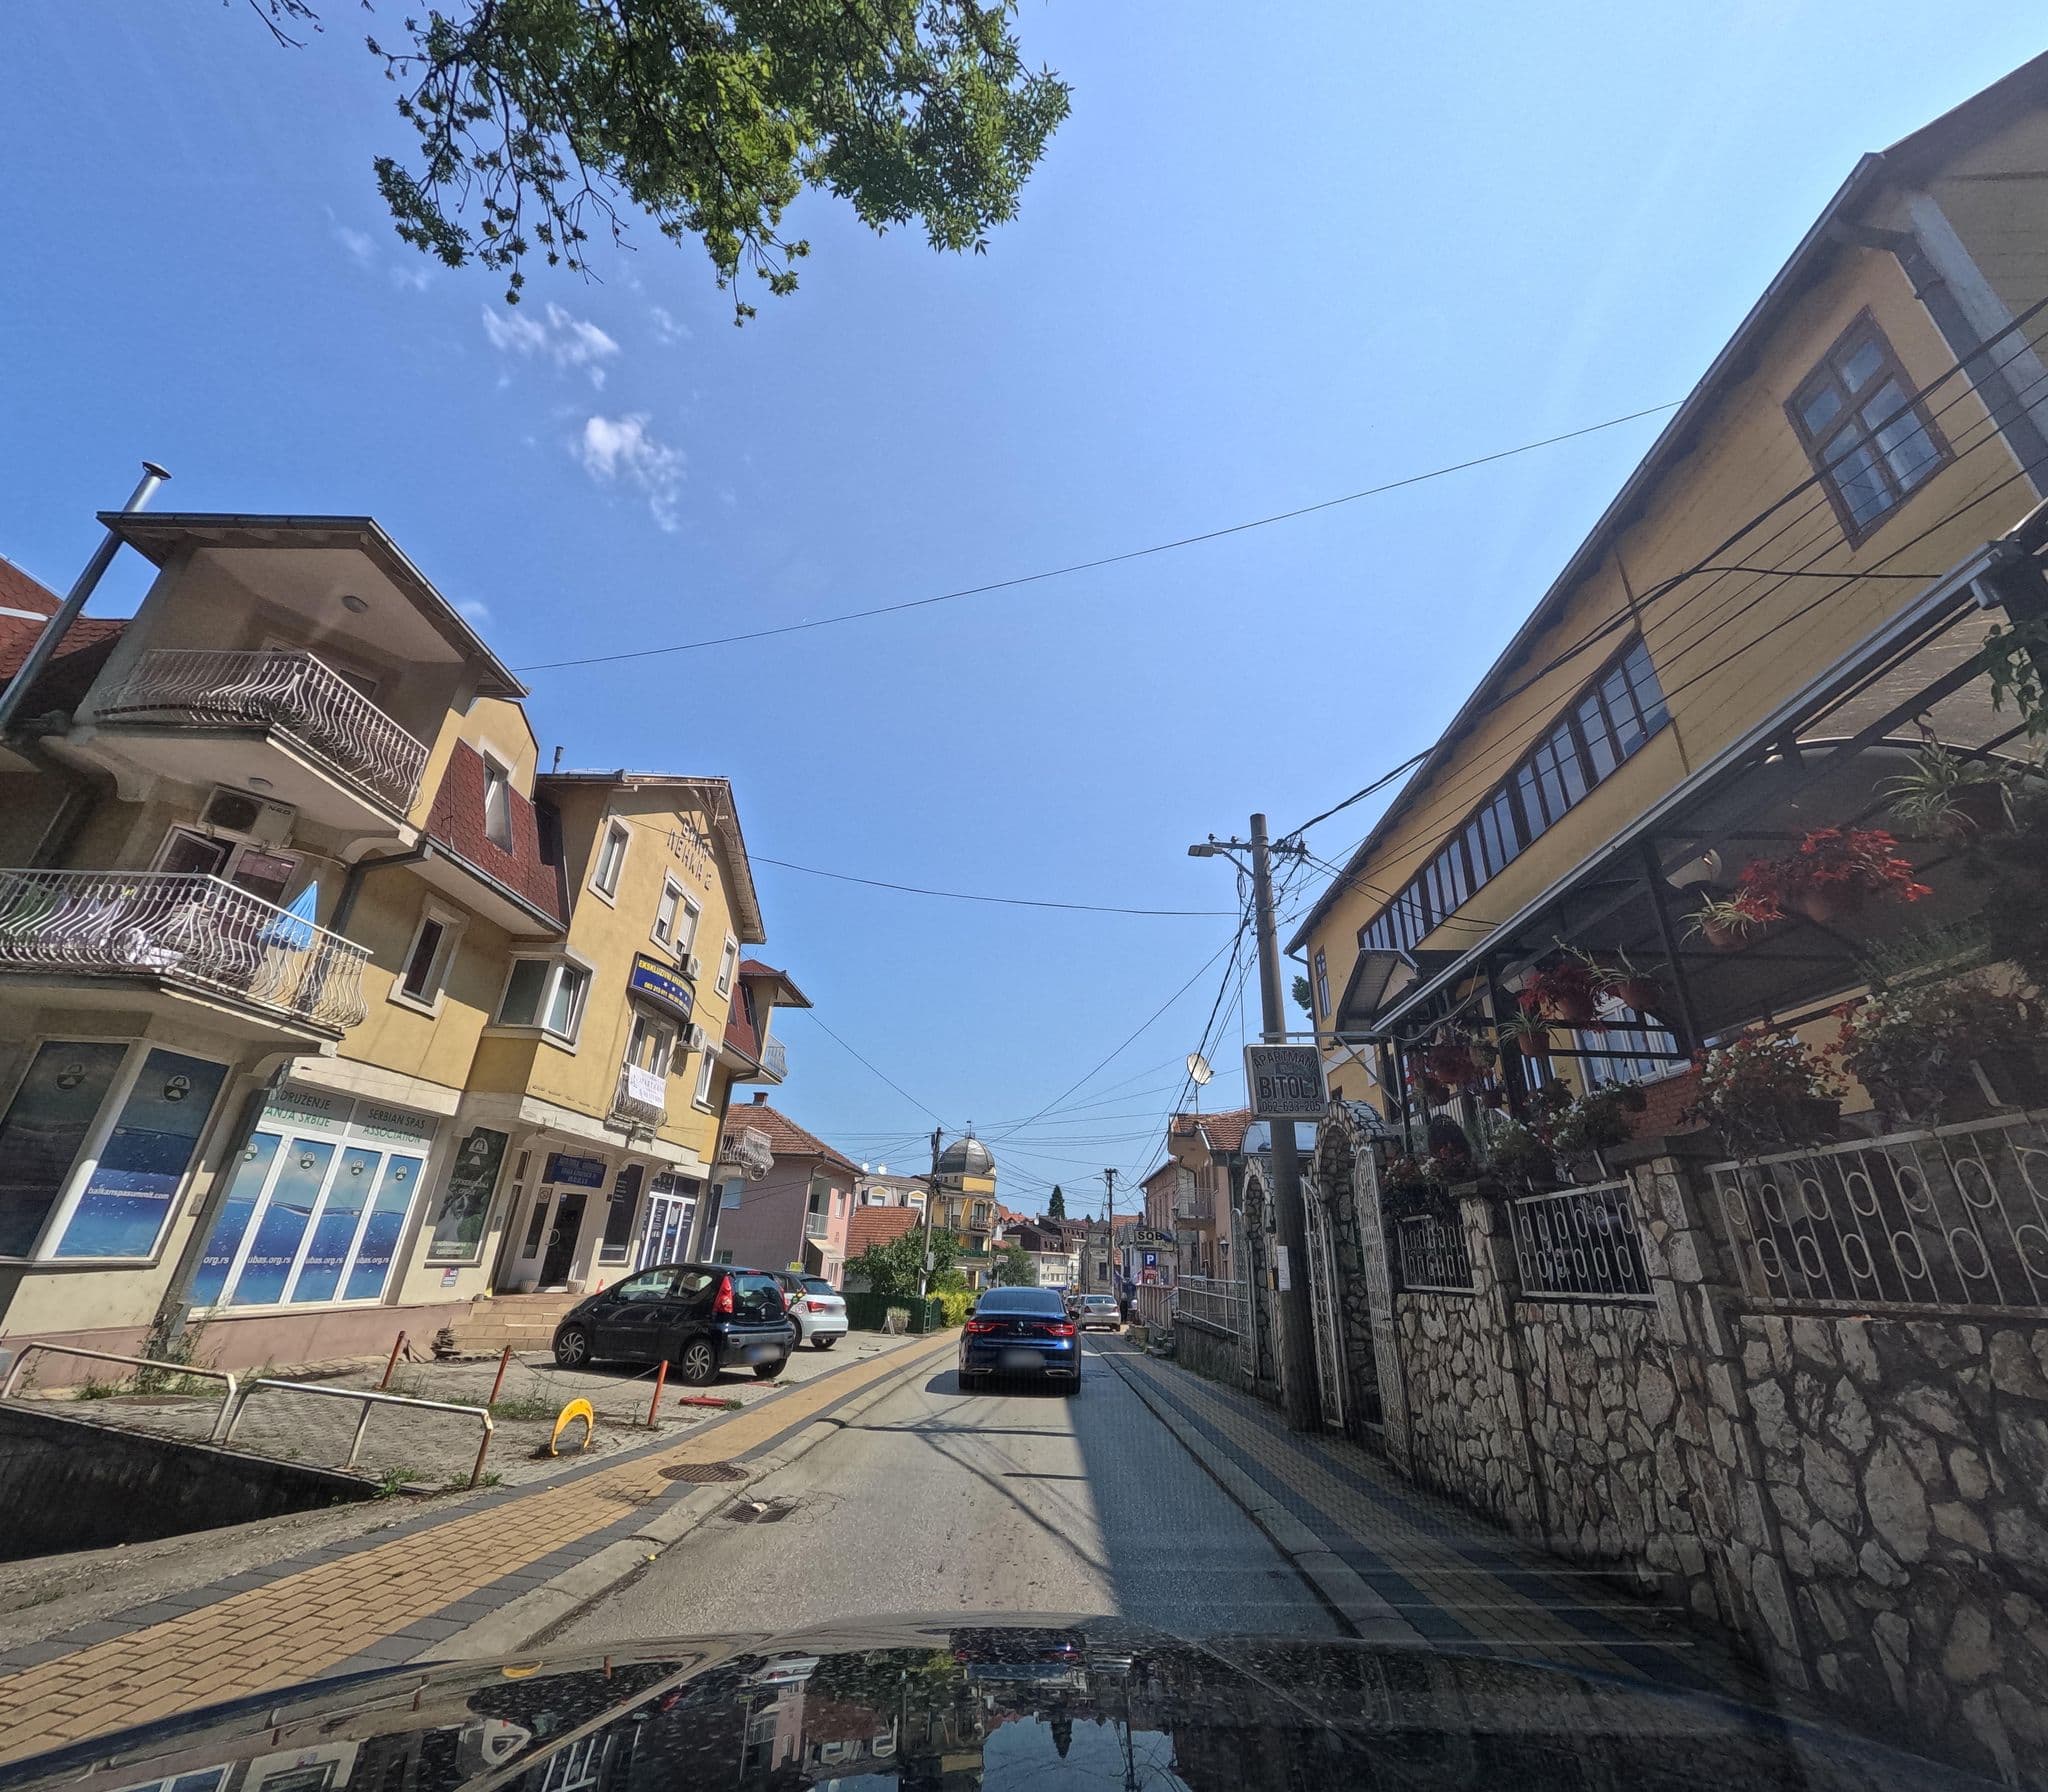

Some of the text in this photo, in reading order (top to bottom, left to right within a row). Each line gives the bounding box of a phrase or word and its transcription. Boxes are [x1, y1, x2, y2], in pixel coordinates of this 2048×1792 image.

[1252, 1050, 1318, 1070] APARTMANI
[1259, 1076, 1319, 1099] BITOLJ
[264, 1106, 331, 1127] ANJA SRBIJE
[368, 1109, 426, 1130] SERBIAN SPAS
[361, 1125, 423, 1143] ASSOCIATION
[247, 1255, 291, 1265] ubas.org.rs
[1146, 1254, 1154, 1265] P
